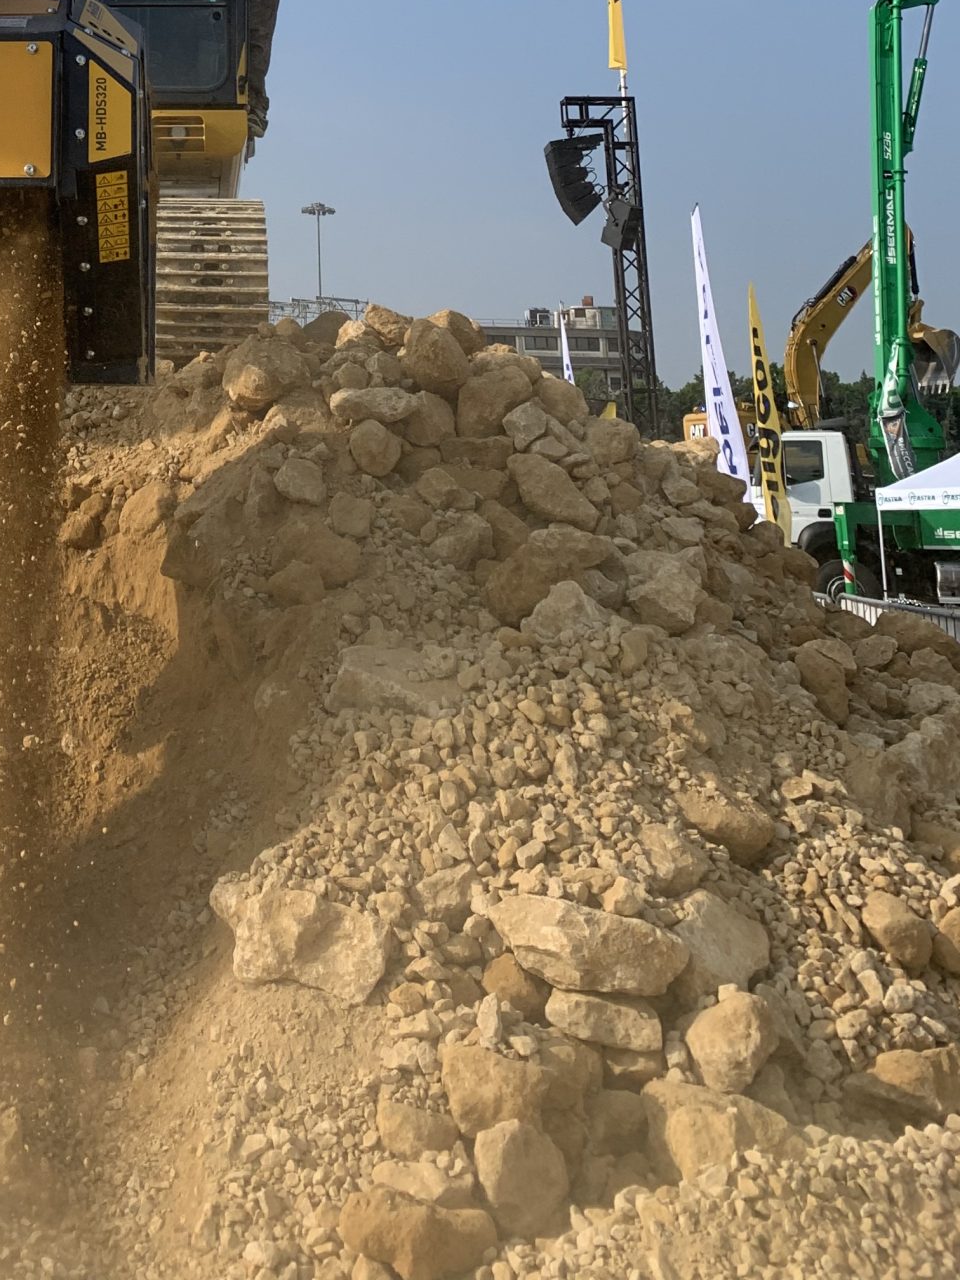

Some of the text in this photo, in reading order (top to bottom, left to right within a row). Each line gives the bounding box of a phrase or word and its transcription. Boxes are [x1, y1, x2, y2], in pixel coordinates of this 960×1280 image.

[96, 77, 107, 152] MB-HDS320
[885, 188, 896, 257] SERMAC
[836, 286, 854, 307] CAT
[689, 424, 705, 440] CAT
